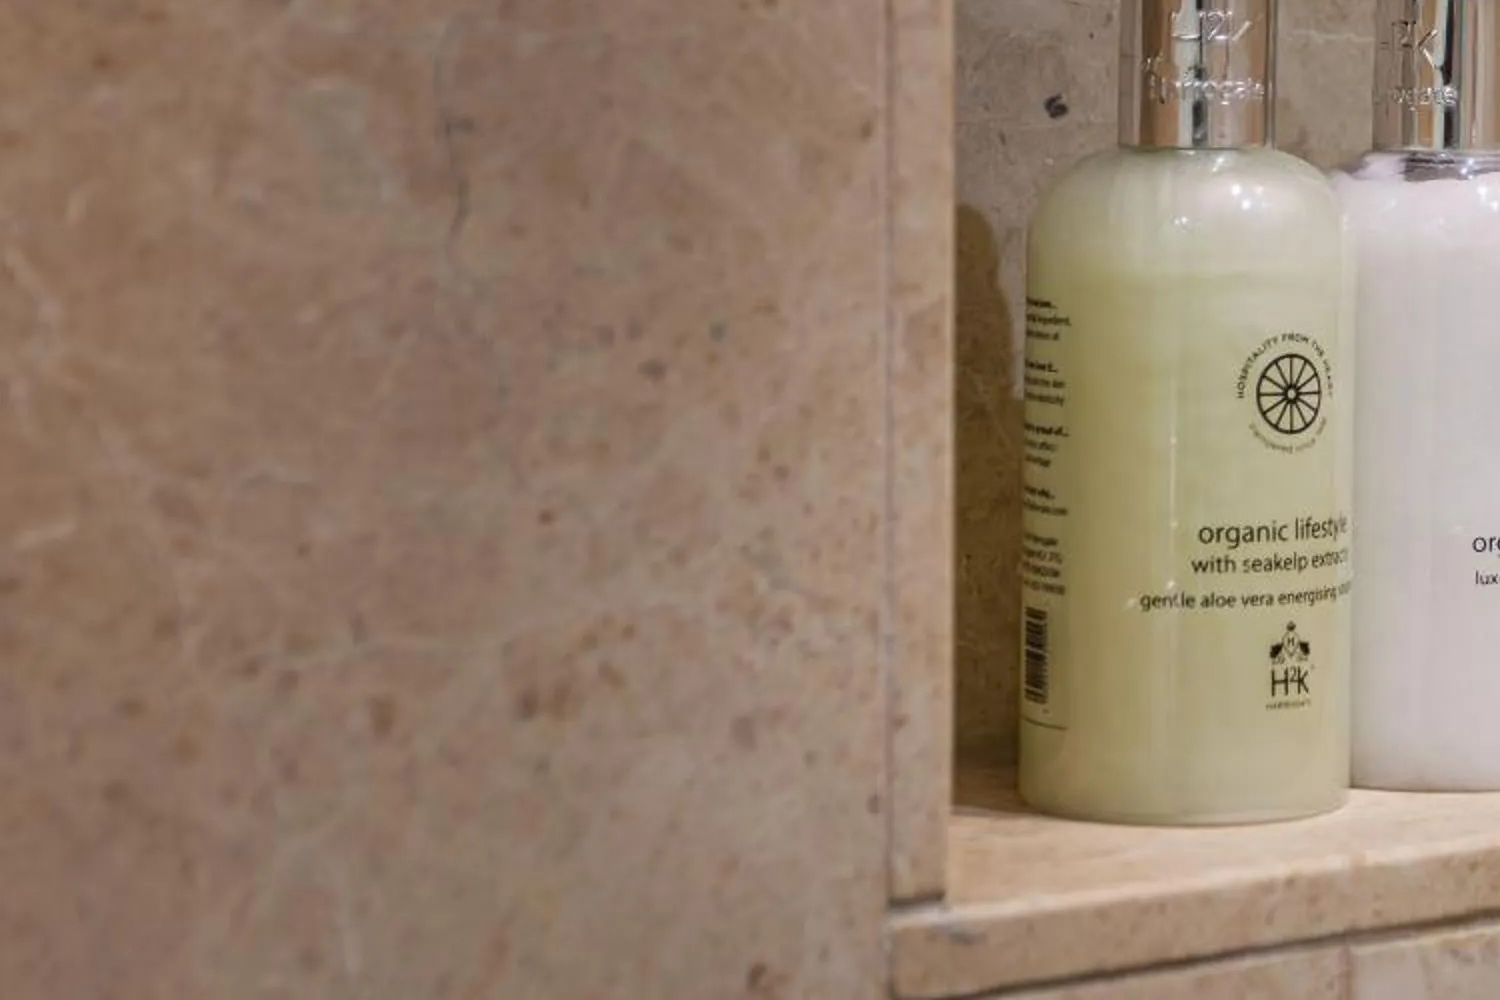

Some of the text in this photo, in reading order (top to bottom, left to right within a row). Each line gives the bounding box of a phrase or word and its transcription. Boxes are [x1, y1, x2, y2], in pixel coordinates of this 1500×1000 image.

[1198, 519, 1290, 550] organic
[1190, 554, 1237, 575] with
[1242, 551, 1309, 576] seakelp
[1140, 591, 1197, 612] gentle
[1200, 591, 1238, 609] aloe
[1241, 592, 1274, 607] vera
[1277, 585, 1338, 607] energising
